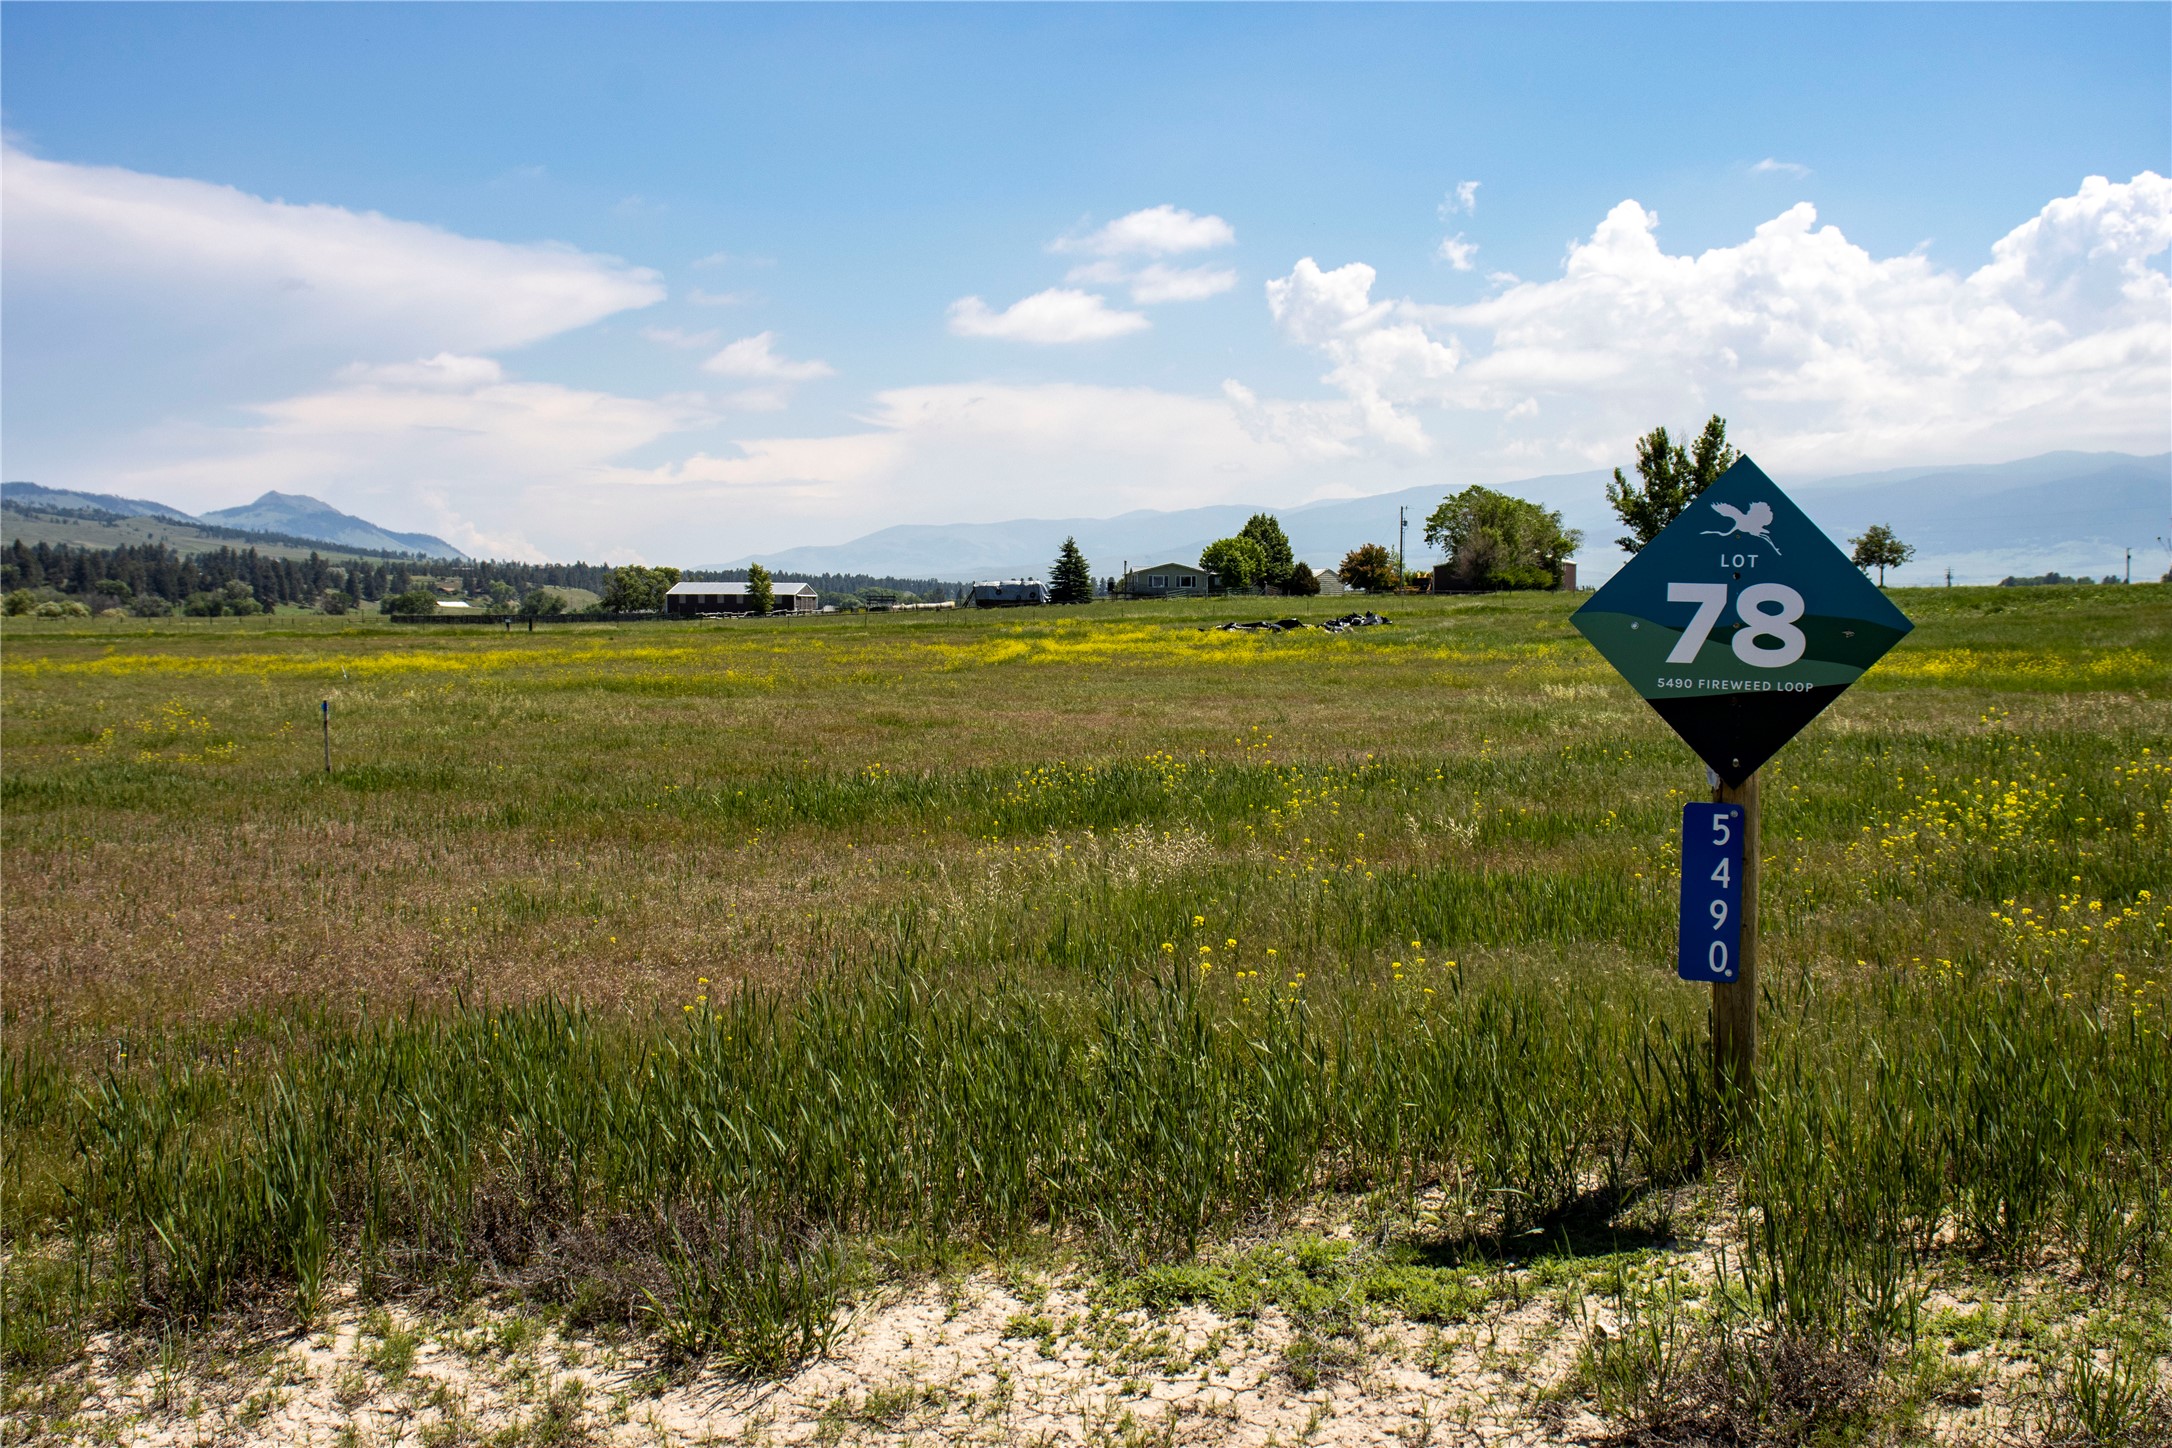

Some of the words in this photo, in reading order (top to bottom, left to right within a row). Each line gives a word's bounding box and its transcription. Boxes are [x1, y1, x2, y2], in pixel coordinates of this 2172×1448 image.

[1720, 554, 1759, 568] LOT
[1665, 582, 1807, 668] 78
[1657, 678, 1693, 689] 5490
[1698, 679, 1772, 692] FIREWEED
[1777, 682, 1814, 693] LOOP
[1708, 813, 1731, 973] 5490
